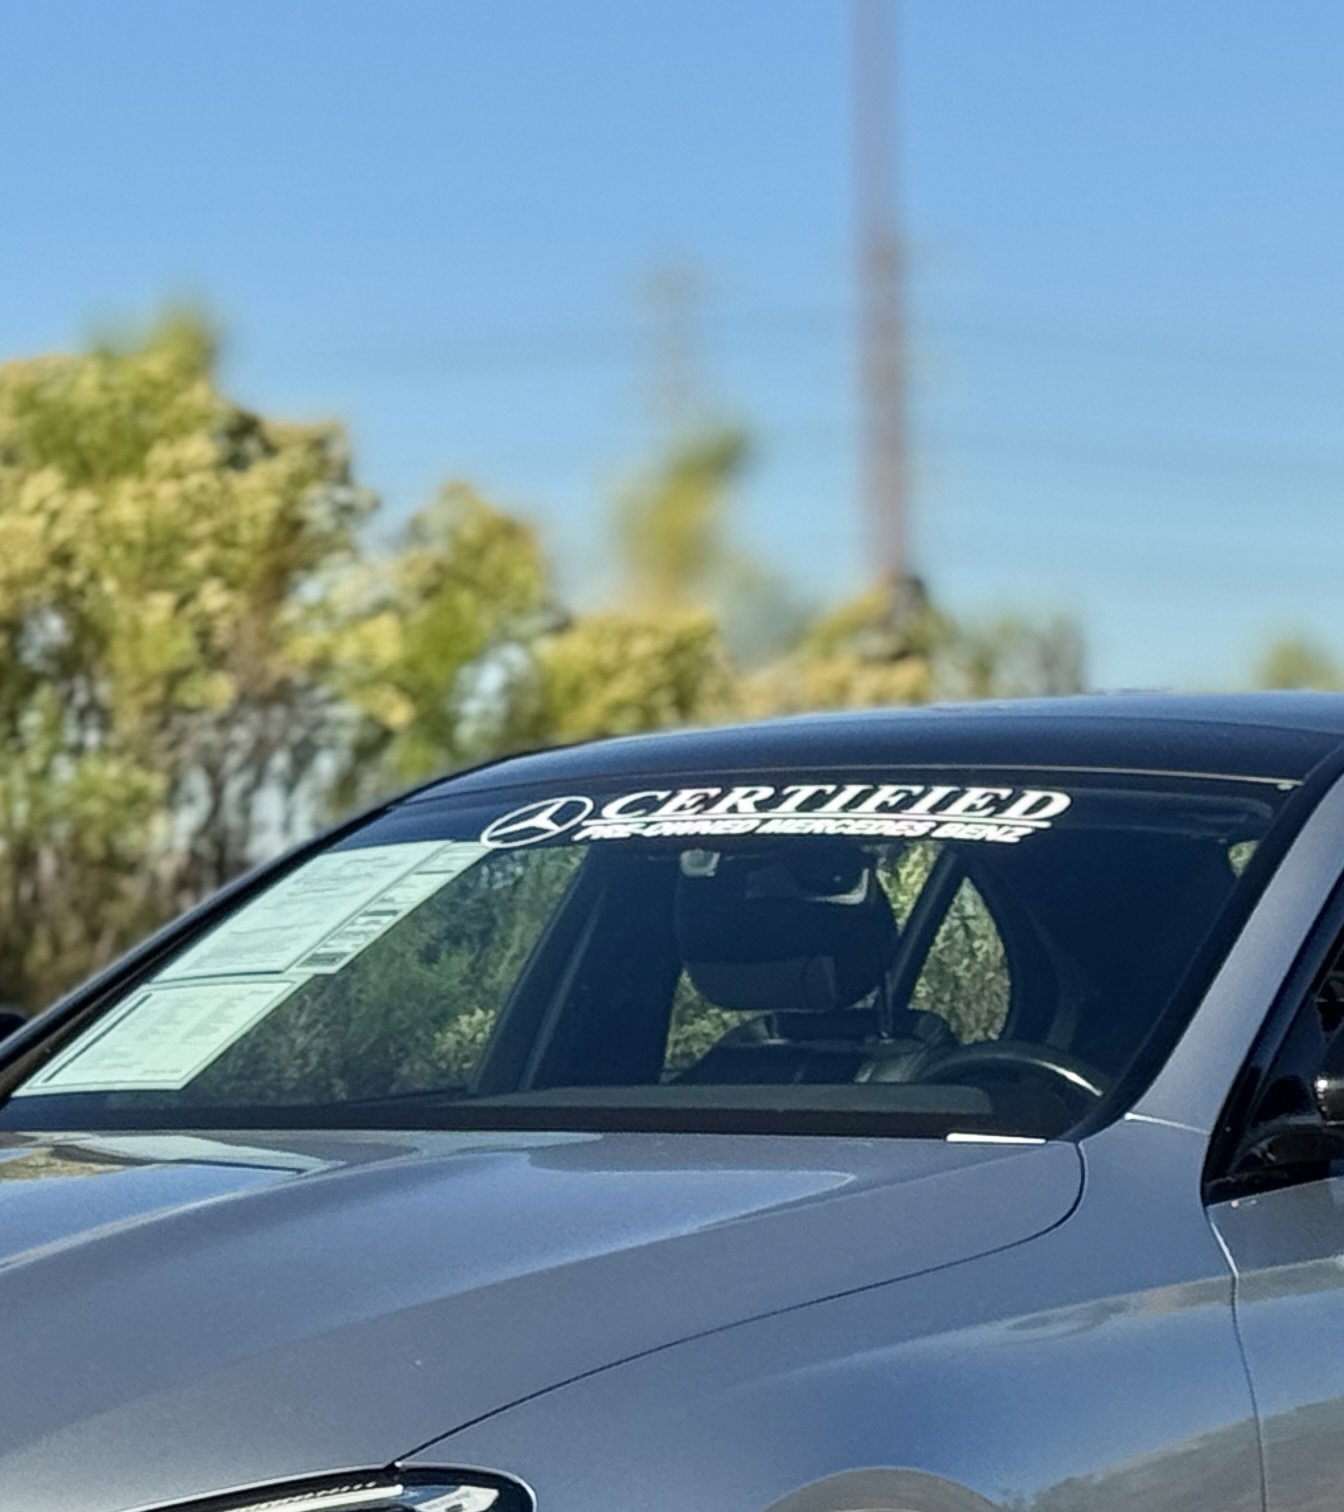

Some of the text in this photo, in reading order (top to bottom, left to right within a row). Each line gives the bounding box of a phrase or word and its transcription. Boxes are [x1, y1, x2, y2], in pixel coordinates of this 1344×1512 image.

[601, 784, 1072, 820] CERTIFIED
[571, 818, 1036, 844] PRE-OWNED MERCEDES BENZ
